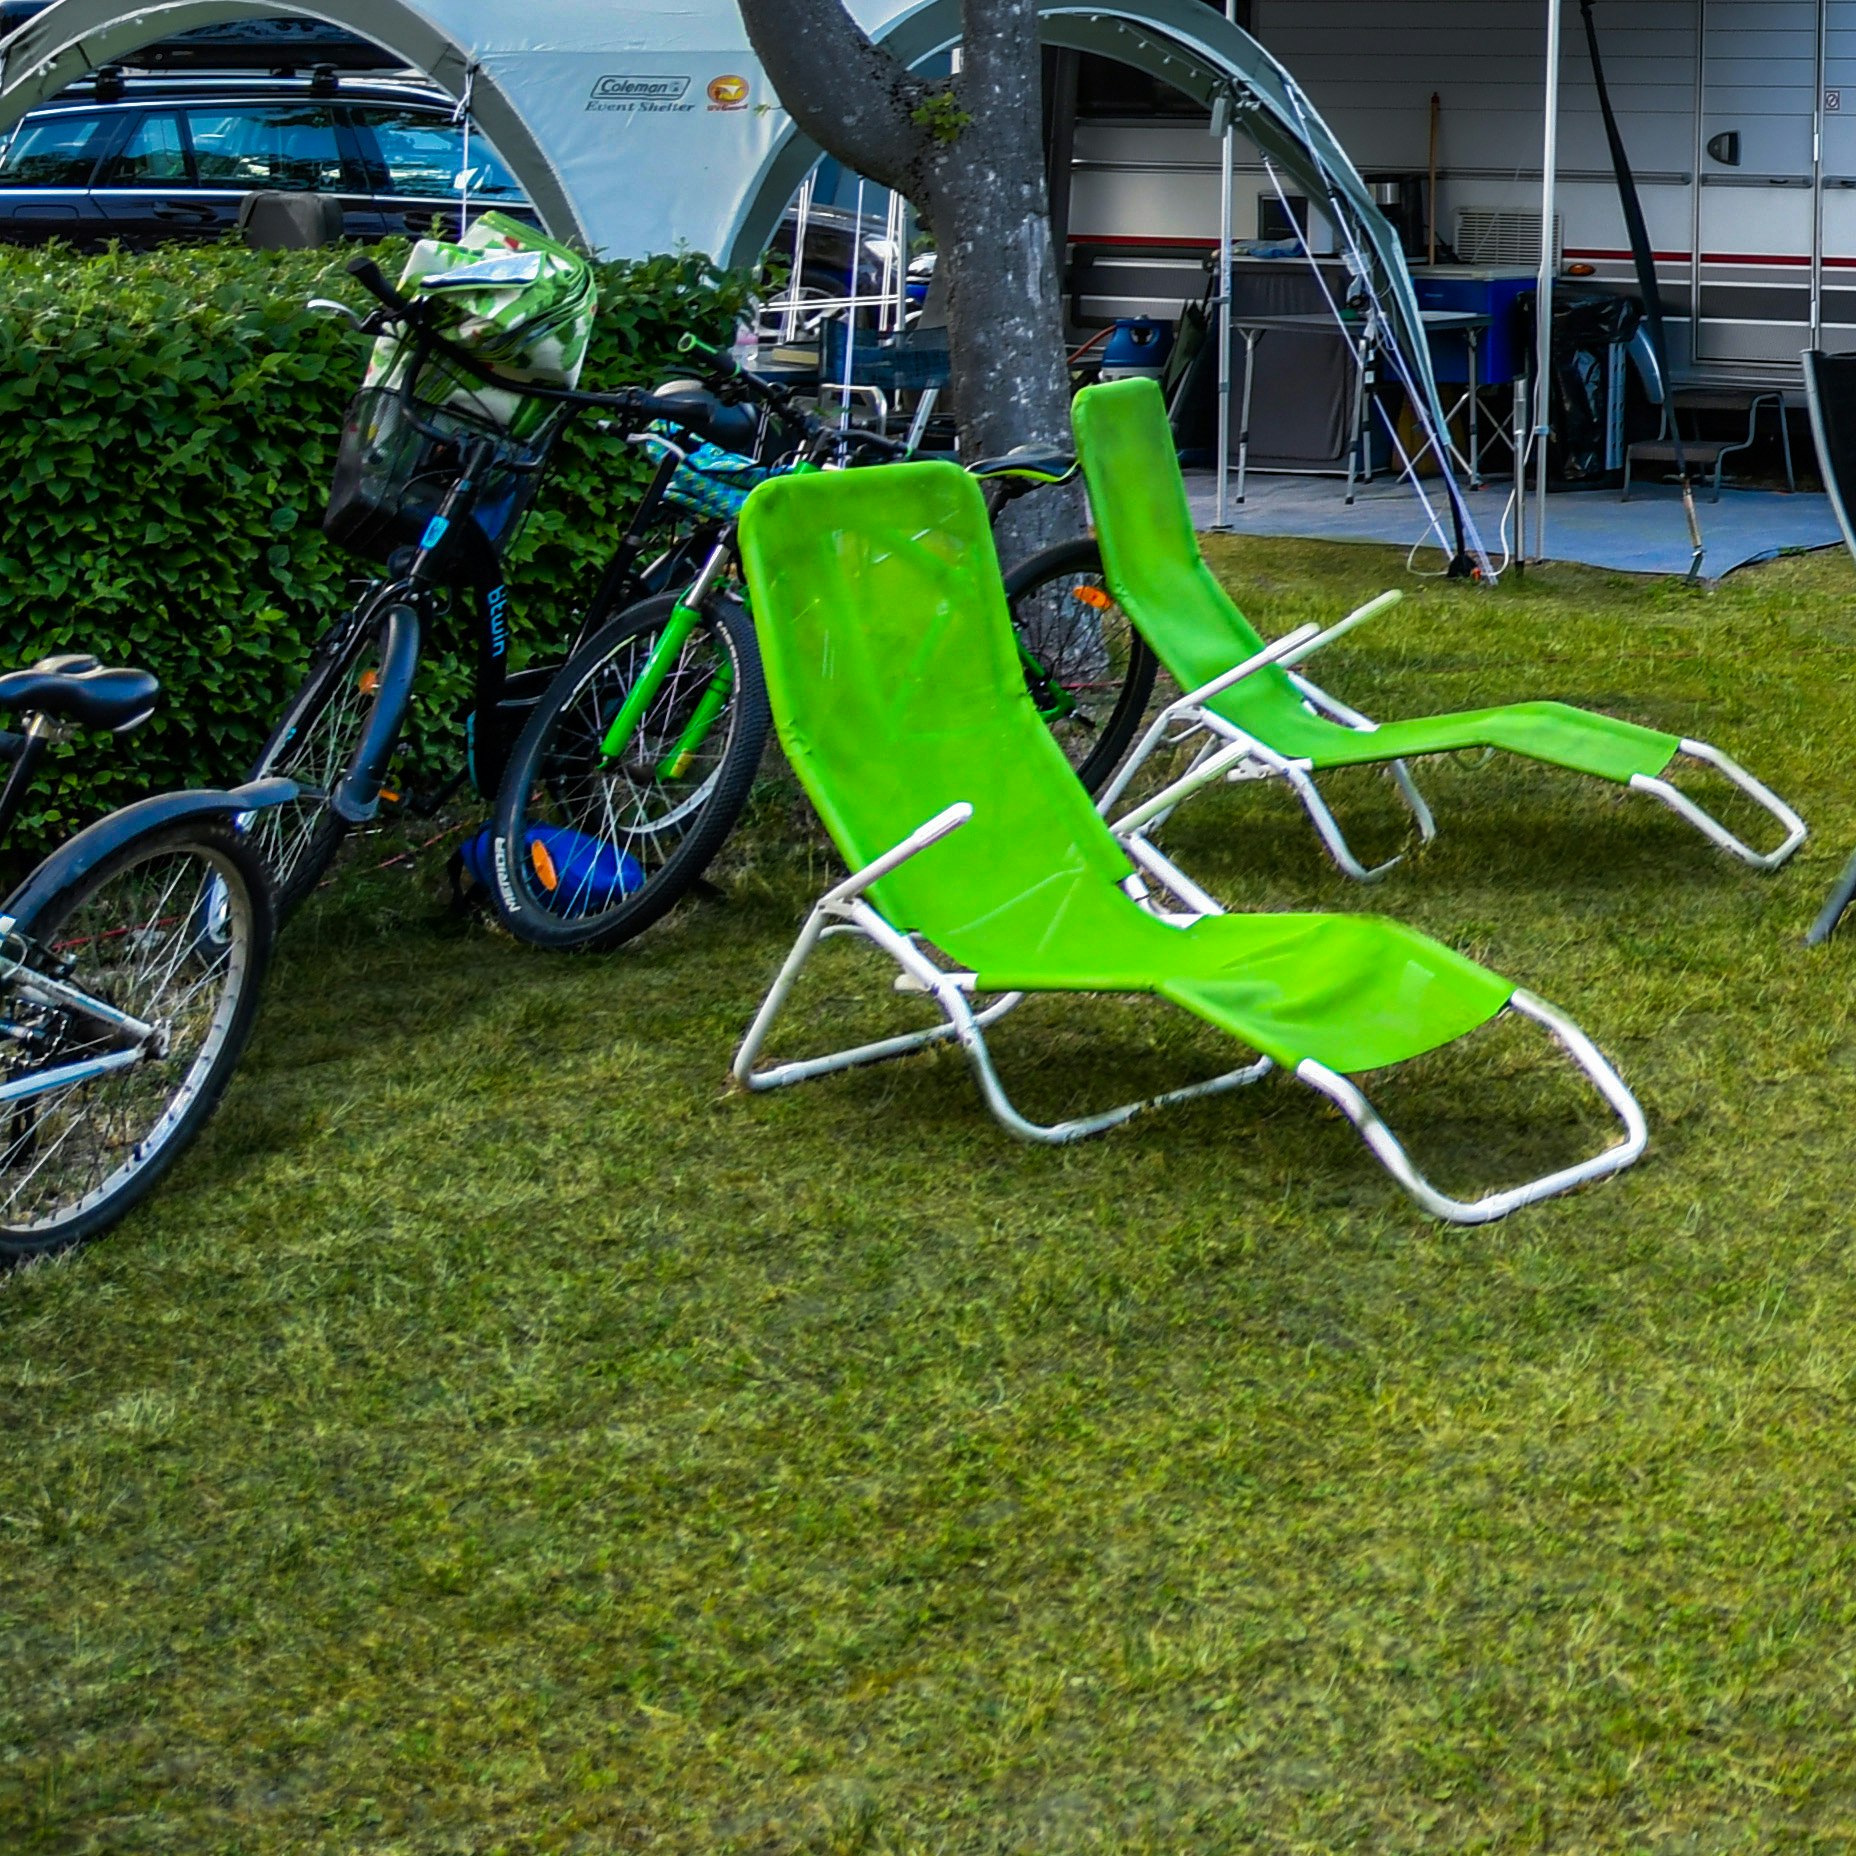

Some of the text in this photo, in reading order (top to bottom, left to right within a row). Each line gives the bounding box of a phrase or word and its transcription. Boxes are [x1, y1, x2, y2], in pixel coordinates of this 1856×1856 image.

[600, 78, 668, 93] Coleman
[585, 100, 696, 113] Event Shelter
[494, 837, 522, 913] MERIDA
